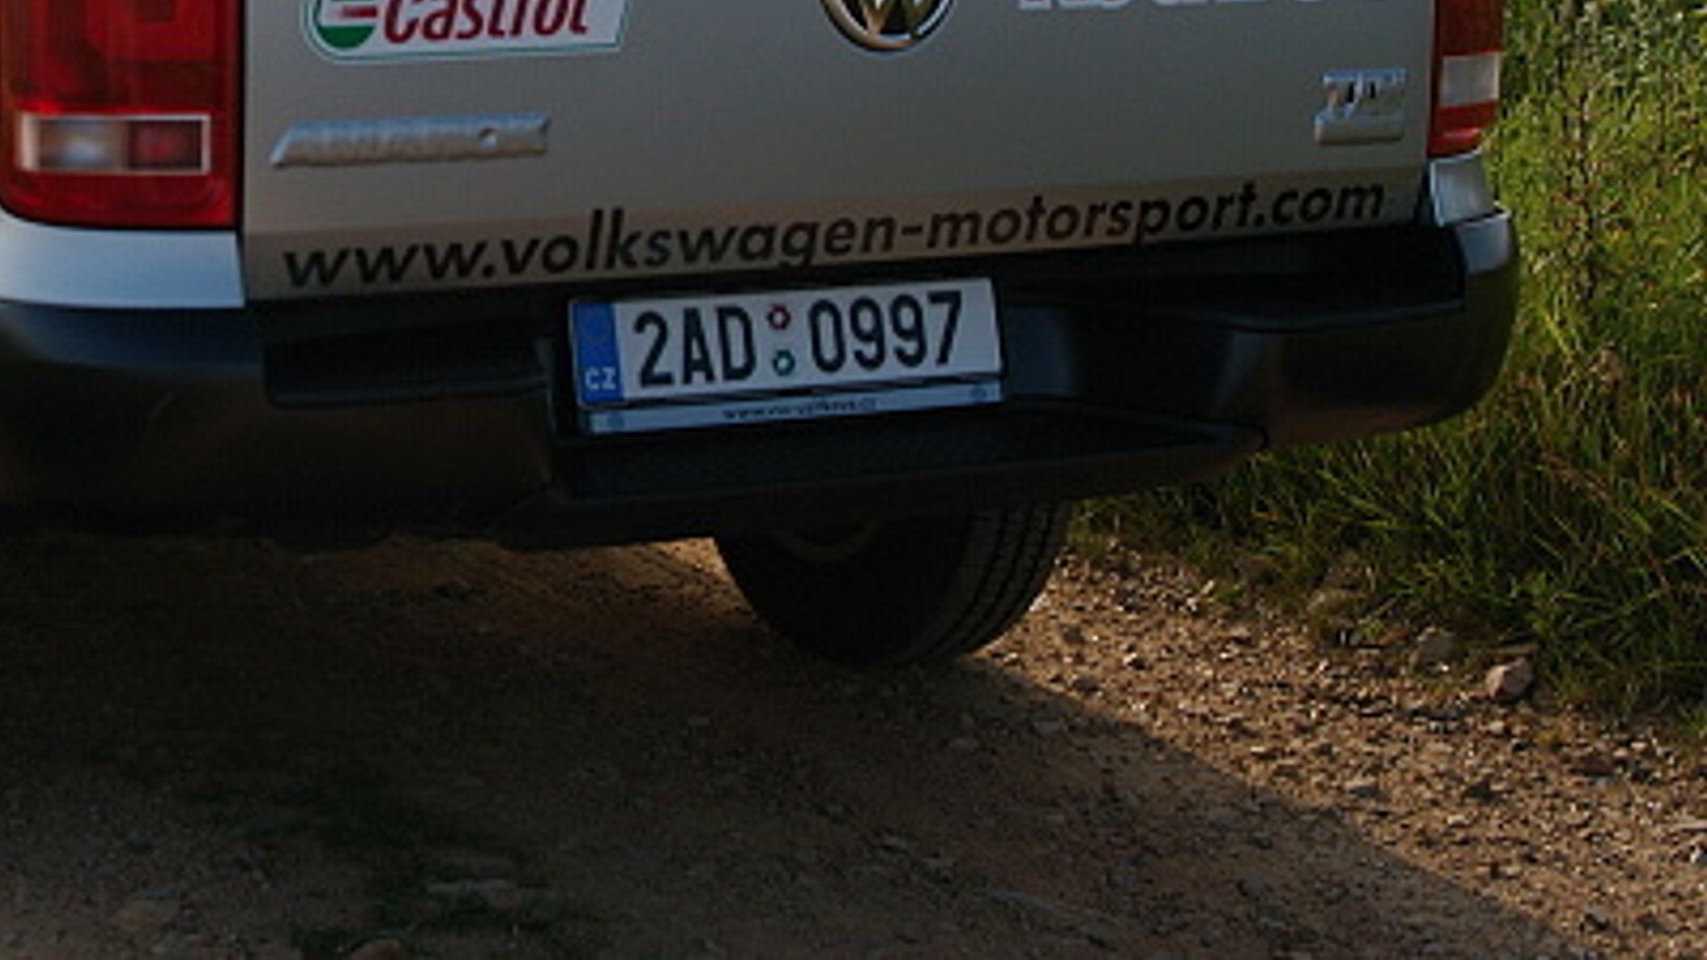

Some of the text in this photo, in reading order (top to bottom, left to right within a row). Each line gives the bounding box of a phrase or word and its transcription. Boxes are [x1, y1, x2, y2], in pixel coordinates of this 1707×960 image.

[282, 180, 1385, 288] www.volkswagen-motorsport.com
[584, 365, 618, 392] CZ
[632, 290, 963, 389] 2AD 0997
